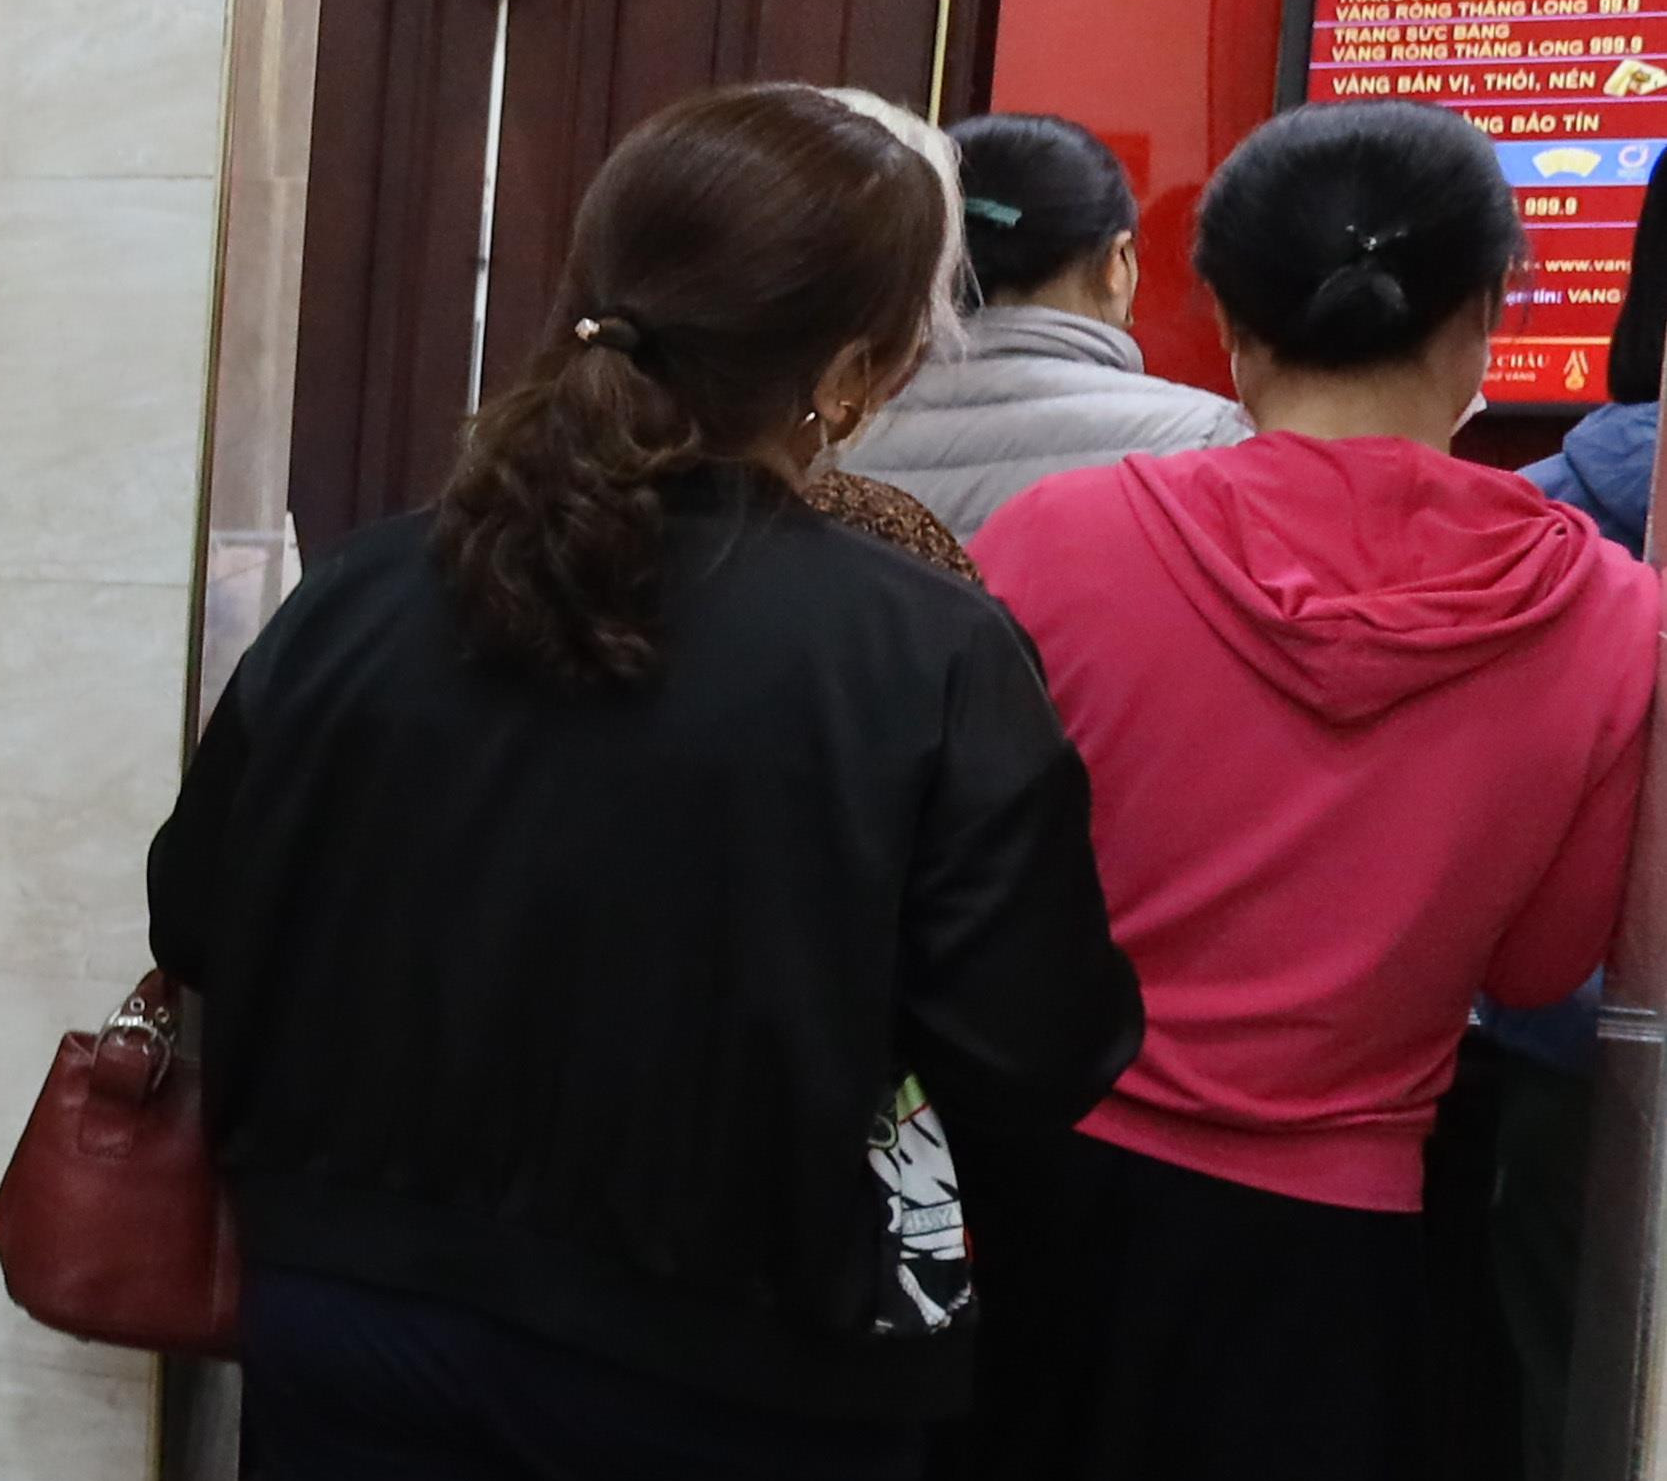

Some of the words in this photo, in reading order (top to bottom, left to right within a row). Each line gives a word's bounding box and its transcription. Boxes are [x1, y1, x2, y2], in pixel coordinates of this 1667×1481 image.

[1334, 25, 1401, 44] TRANG
[1527, 38, 1584, 57] LONG
[1589, 36, 1643, 55] 999.9
[1333, 71, 1390, 95] VÀNG
